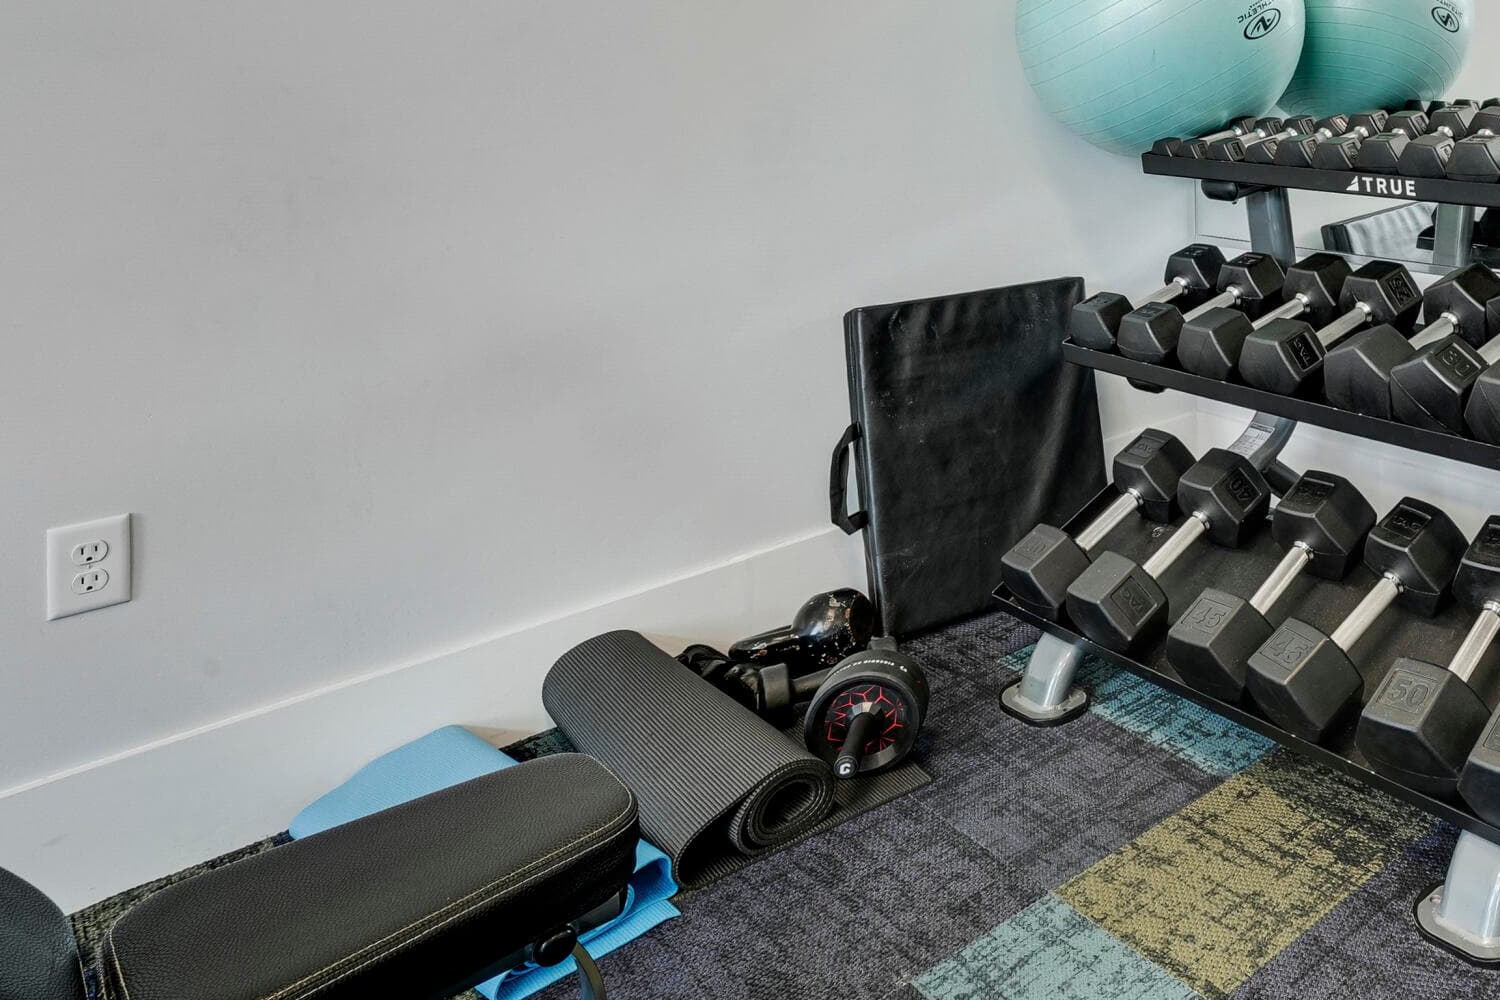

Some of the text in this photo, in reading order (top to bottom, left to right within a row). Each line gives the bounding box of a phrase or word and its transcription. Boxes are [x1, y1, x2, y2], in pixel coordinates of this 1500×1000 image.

[1361, 176, 1417, 197] TRUE
[1228, 477, 1253, 501] 40
[1190, 606, 1227, 629] 45
[1268, 635, 1309, 664] 45
[1388, 679, 1430, 708] 50
